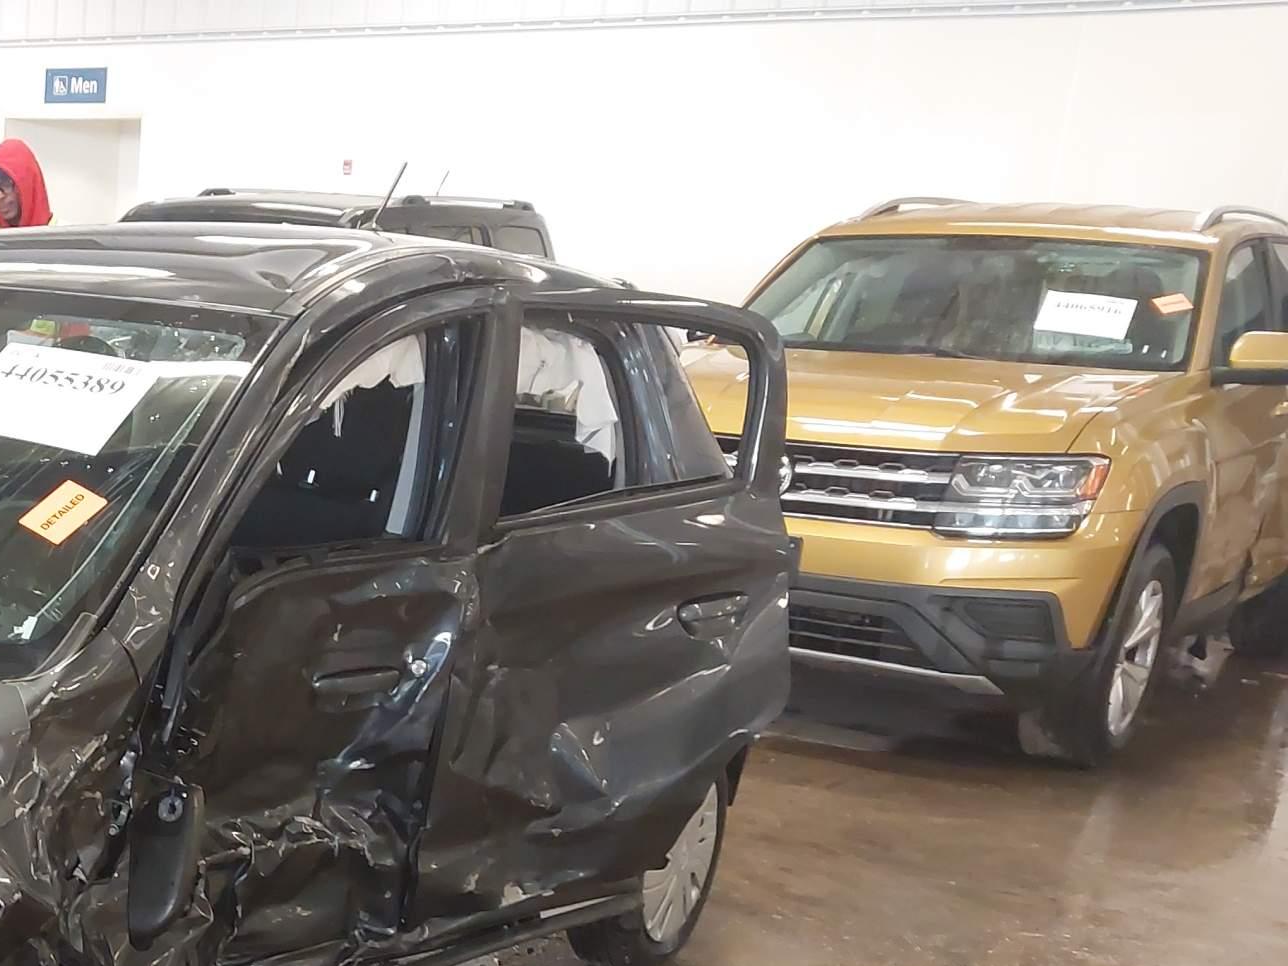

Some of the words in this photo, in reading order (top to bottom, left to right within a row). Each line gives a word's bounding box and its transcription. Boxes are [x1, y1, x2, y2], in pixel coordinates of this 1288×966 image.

[70, 76, 98, 94] Men
[1, 364, 126, 394] 44055389
[39, 493, 85, 531] DETAILED
